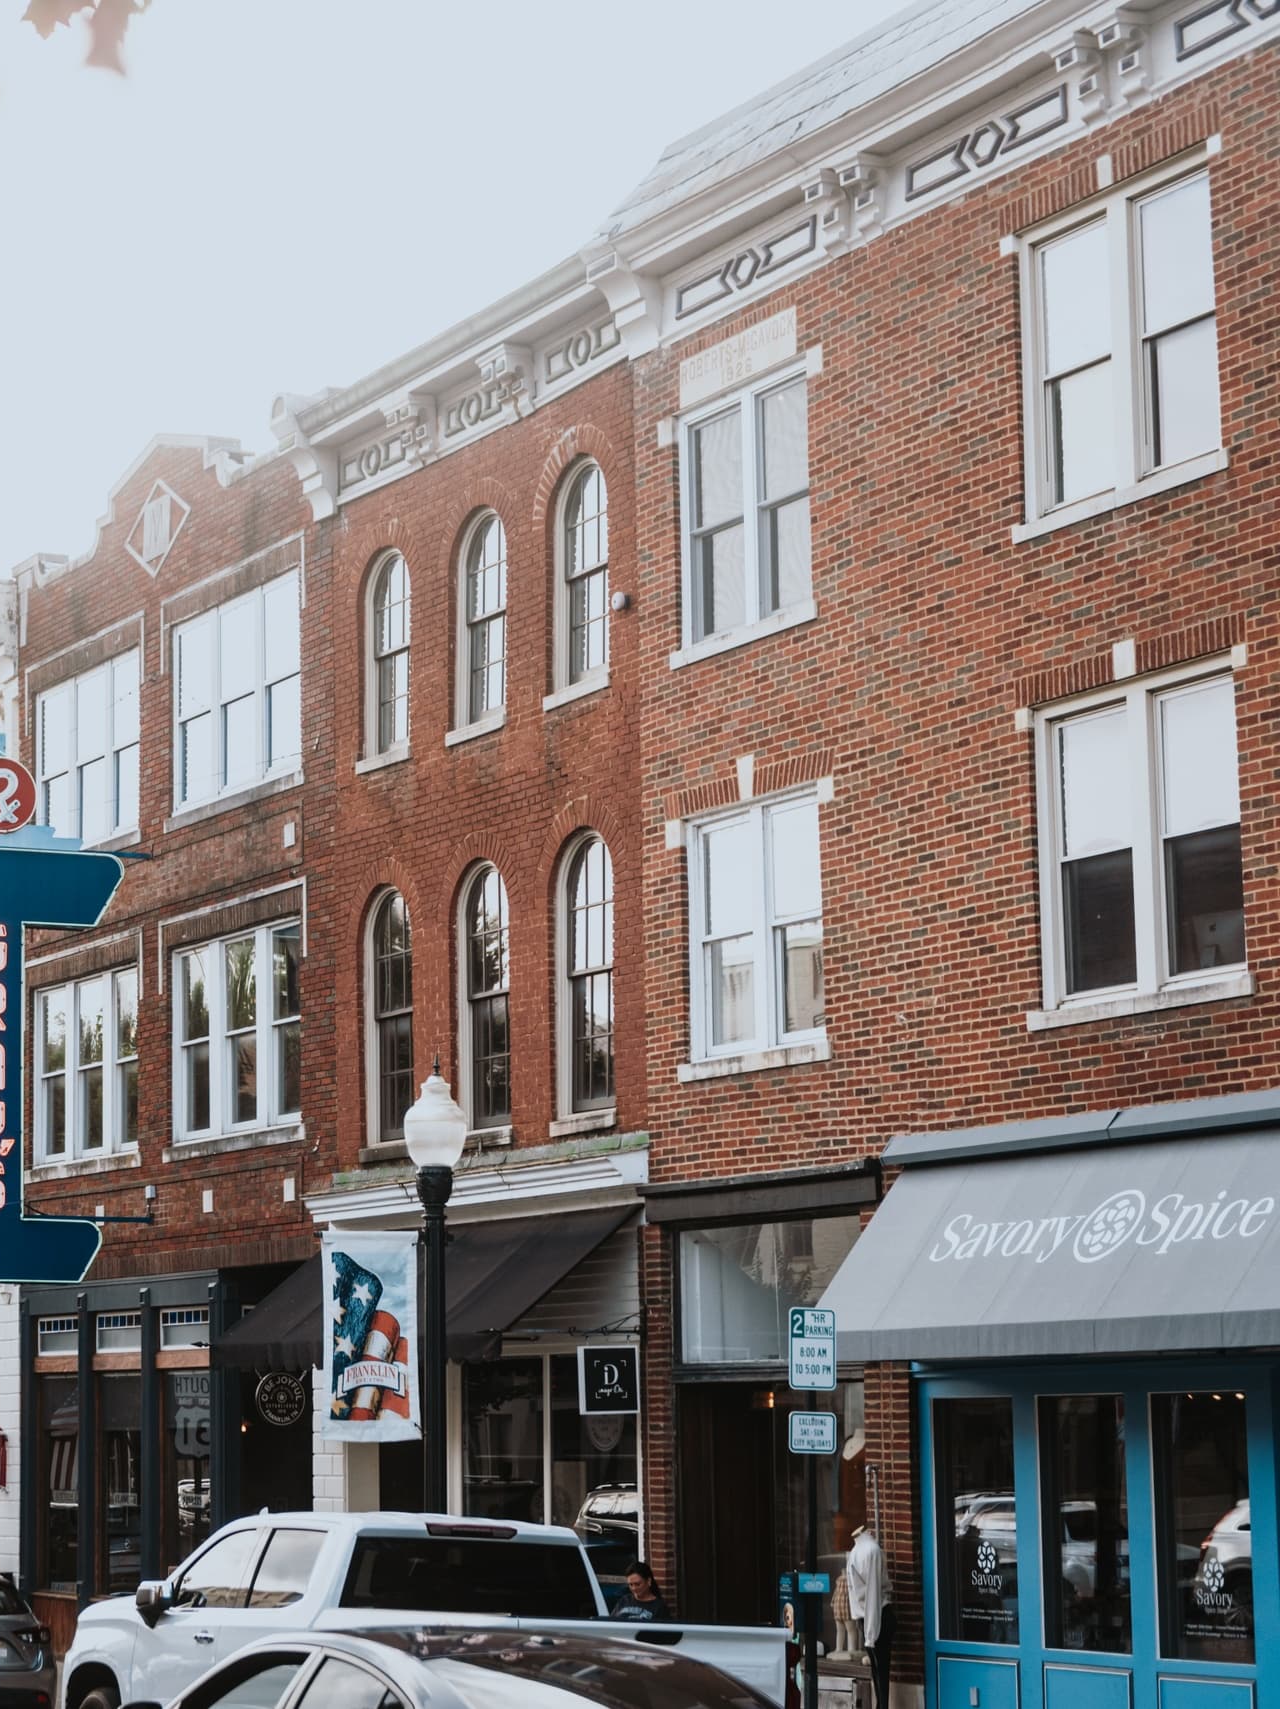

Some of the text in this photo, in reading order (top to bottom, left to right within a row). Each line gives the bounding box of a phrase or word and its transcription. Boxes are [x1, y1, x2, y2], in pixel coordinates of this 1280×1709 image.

[929, 1190, 1275, 1263] Savory Spice
[792, 1313, 803, 1335] 2
[805, 1326, 833, 1336] PARKING
[799, 1347, 827, 1358] 8:00 AM
[346, 1364, 397, 1383] FRANKLIN
[795, 1363, 832, 1375] TO 5:00 PM
[275, 1375, 303, 1402] JOYFUL
[971, 1569, 1003, 1590] Savory
[1196, 1588, 1233, 1610] Savory
